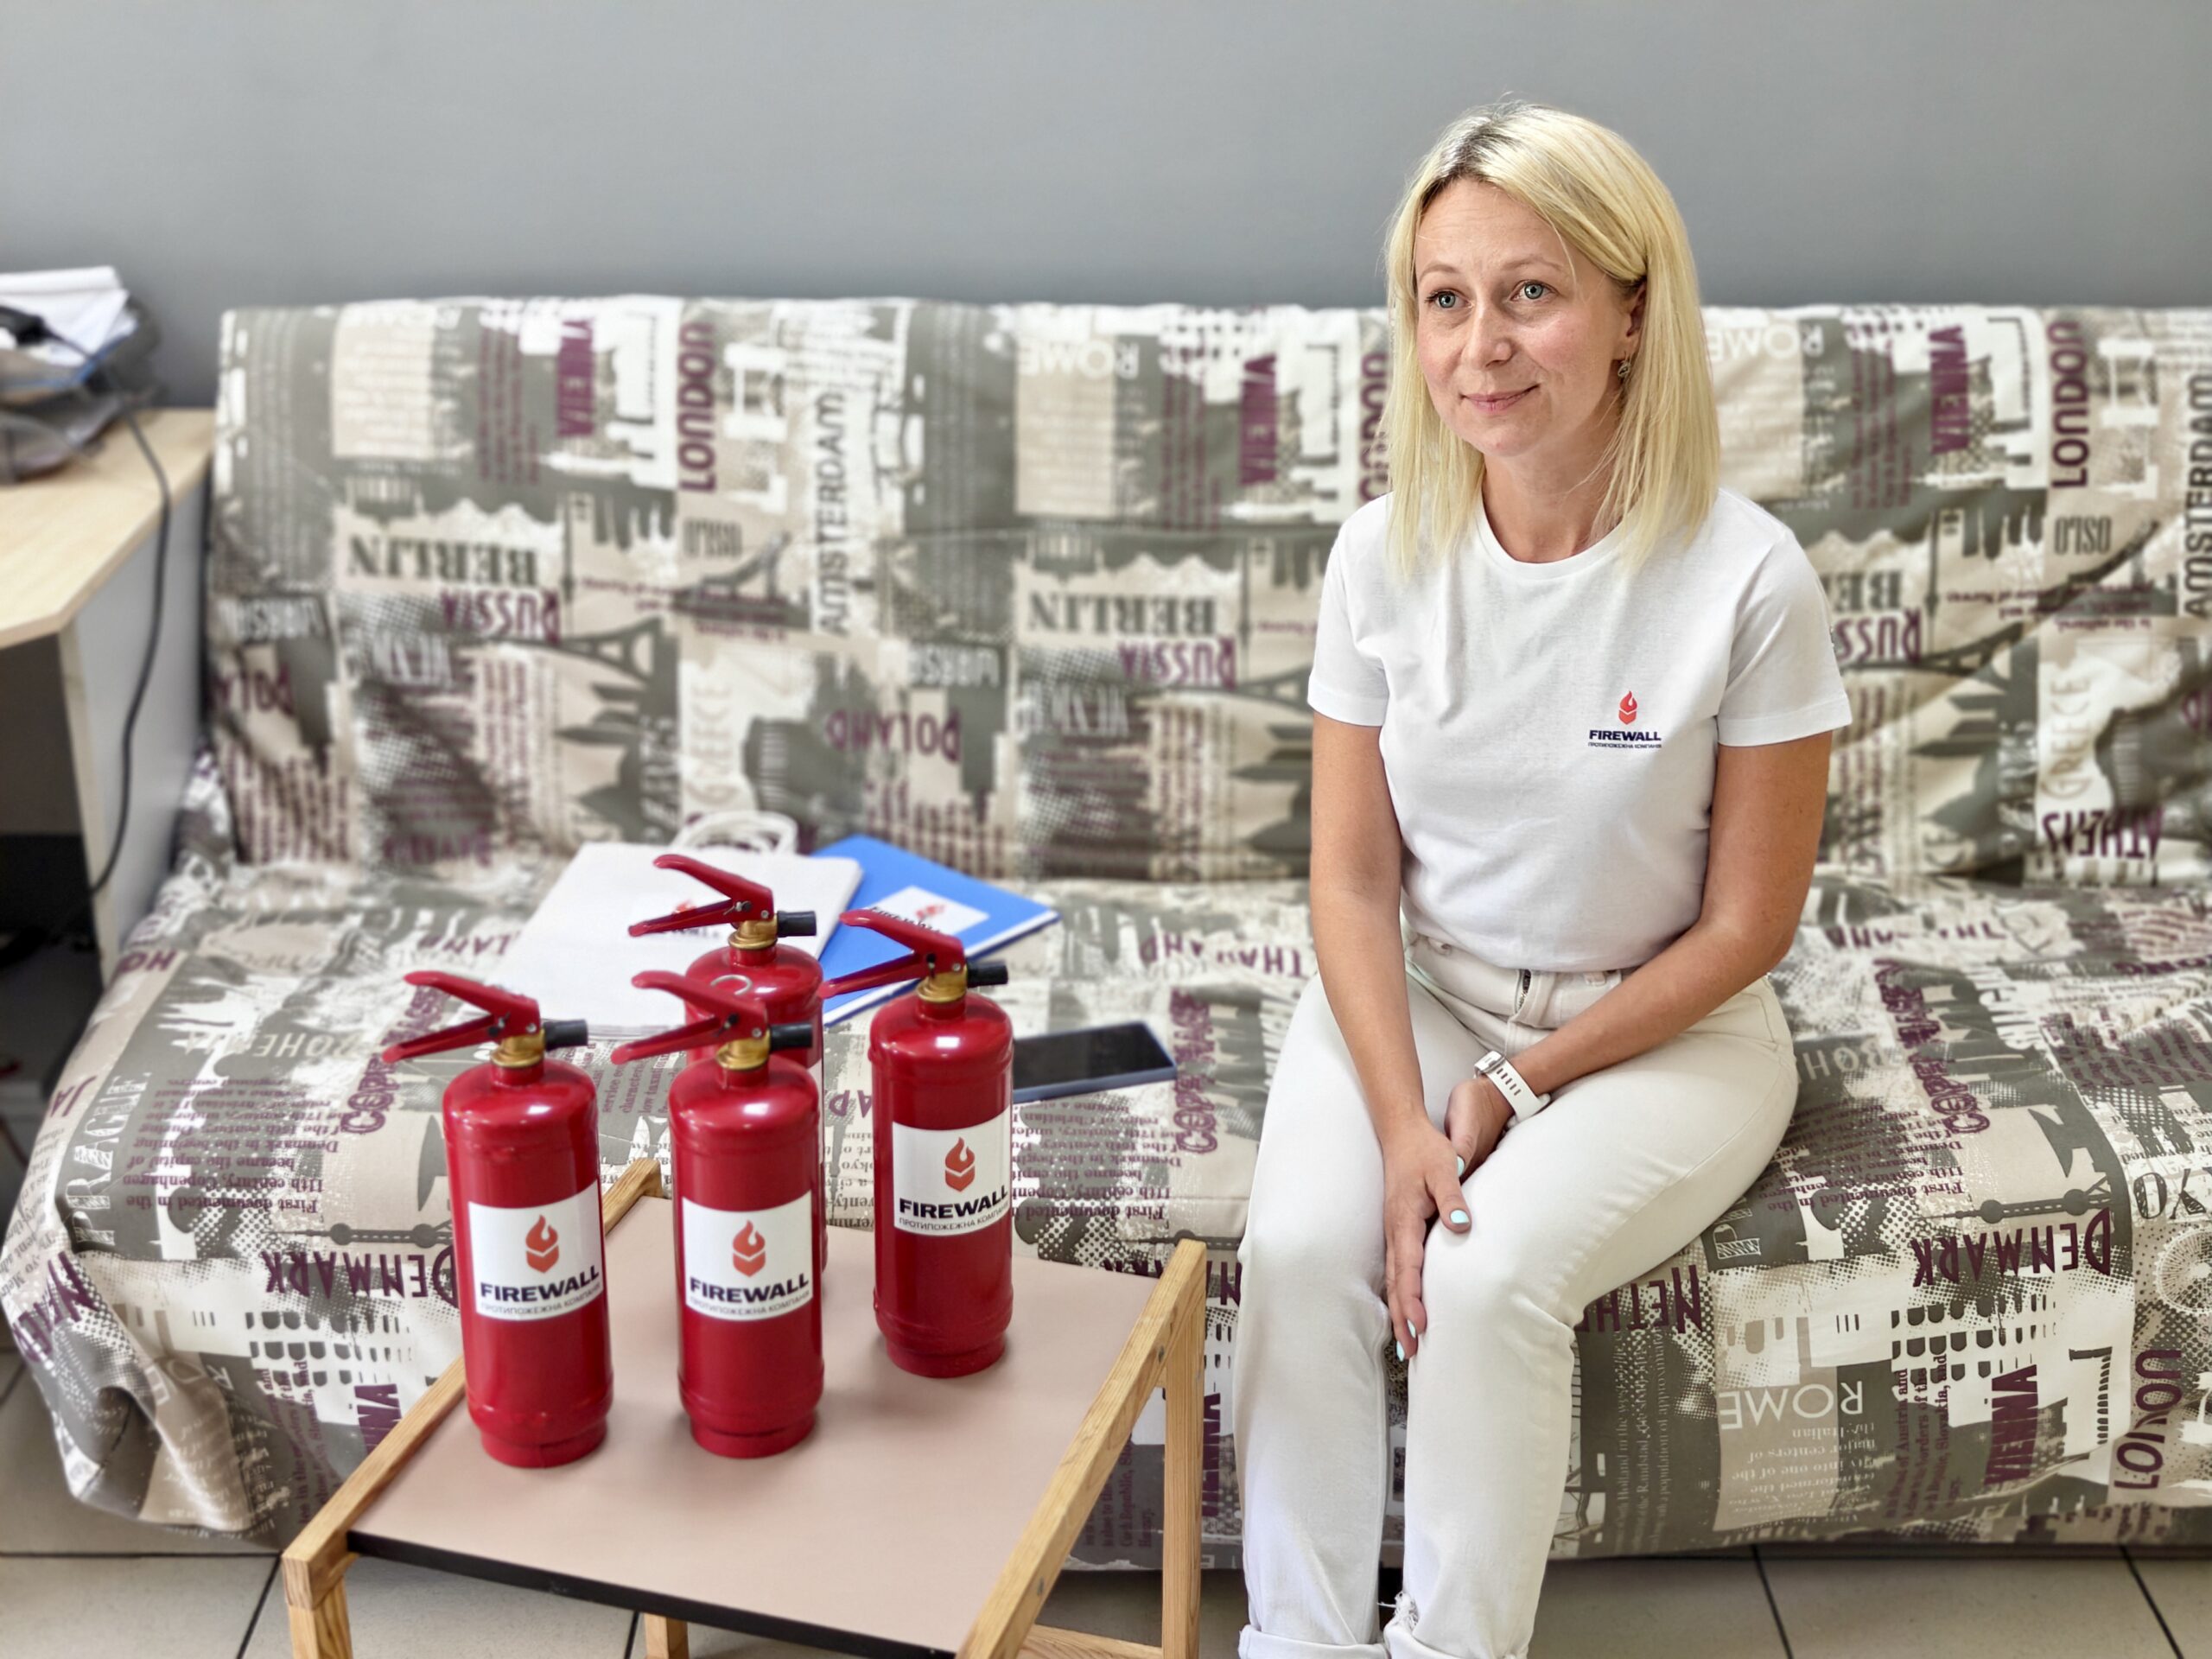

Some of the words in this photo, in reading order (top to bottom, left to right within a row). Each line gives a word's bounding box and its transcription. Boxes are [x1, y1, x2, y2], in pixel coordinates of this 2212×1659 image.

[677, 321, 716, 493] LONDON
[2048, 321, 2089, 489] LONDON
[348, 536, 538, 587] BERLIN
[441, 588, 562, 647] RUSSIA
[1030, 593, 1217, 635] BERLIN
[1834, 607, 1922, 665] RUSS
[1119, 636, 1236, 689] RUSSIA
[1589, 730, 1662, 741] FIREWALL
[126, 1196, 153, 1211] the
[899, 1185, 1008, 1219] FIREWALL
[1923, 1180, 1964, 1197] First
[278, 1198, 318, 1213] First
[1124, 1205, 1165, 1220] First
[899, 1217, 976, 1232] ПРОТИПОЖЕЖНА
[1910, 1207, 2111, 1287] DENMARK
[262, 1245, 458, 1306] DENMARK
[480, 1265, 600, 1303] FIREWALL
[690, 1273, 810, 1304] FIREWALL
[1893, 1368, 1908, 1395] and
[1932, 1353, 1948, 1383] and
[1719, 1381, 1864, 1430] ROME
[2113, 1349, 2183, 1490] LOON
[1792, 1427, 1844, 1440] Italian
[1747, 1451, 1763, 1464] of
[1768, 1446, 1825, 1459] centers
[1732, 1470, 1756, 1482] the
[1760, 1469, 1776, 1479] of
[1782, 1465, 1806, 1475] one
